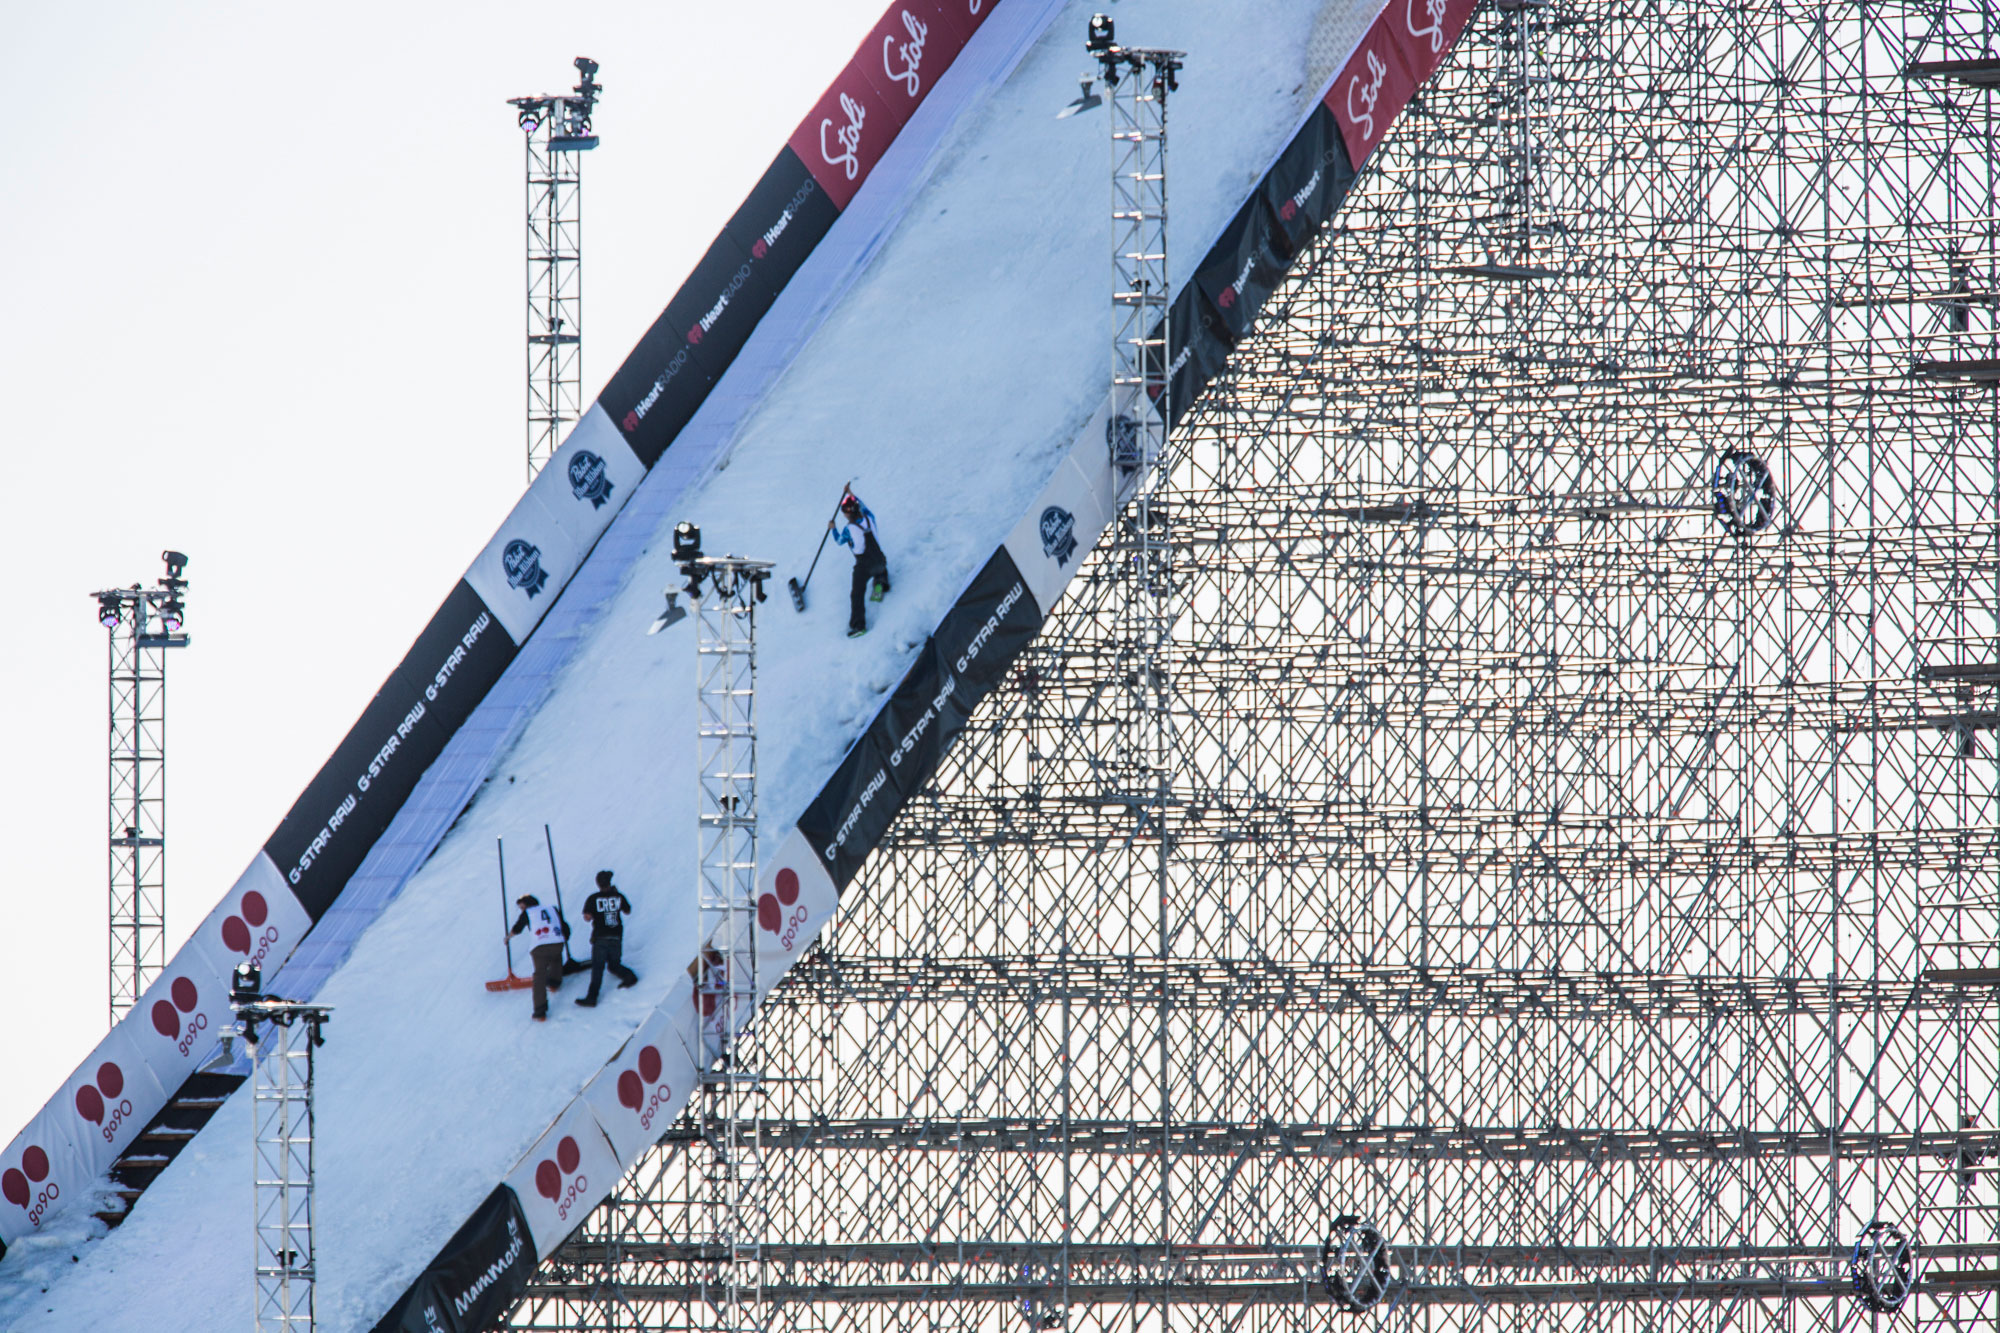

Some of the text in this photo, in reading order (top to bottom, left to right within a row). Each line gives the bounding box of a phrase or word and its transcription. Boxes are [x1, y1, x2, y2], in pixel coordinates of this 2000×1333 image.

[1407, 0, 1448, 53] Sto
[884, 10, 928, 97] Stoli
[1347, 49, 1386, 141] Stoli
[821, 92, 866, 180] Stoli
[956, 582, 1024, 674] G-STAR RAW
[425, 610, 490, 701] G-STAR RAW
[357, 701, 425, 792] G-STAR RAW
[890, 674, 956, 767] G-STAR RAW
[288, 793, 357, 884] G-STAR RAW
[825, 768, 886, 860] G-STAR RAW
[540, 909, 551, 924] 4
[596, 896, 621, 913] CREW
[781, 905, 808, 952] go90
[251, 926, 279, 968] go90
[178, 1013, 207, 1057] go90
[102, 1099, 132, 1143] go90
[640, 1084, 671, 1131] go90
[28, 1183, 59, 1226] go90
[558, 1175, 588, 1221] go90
